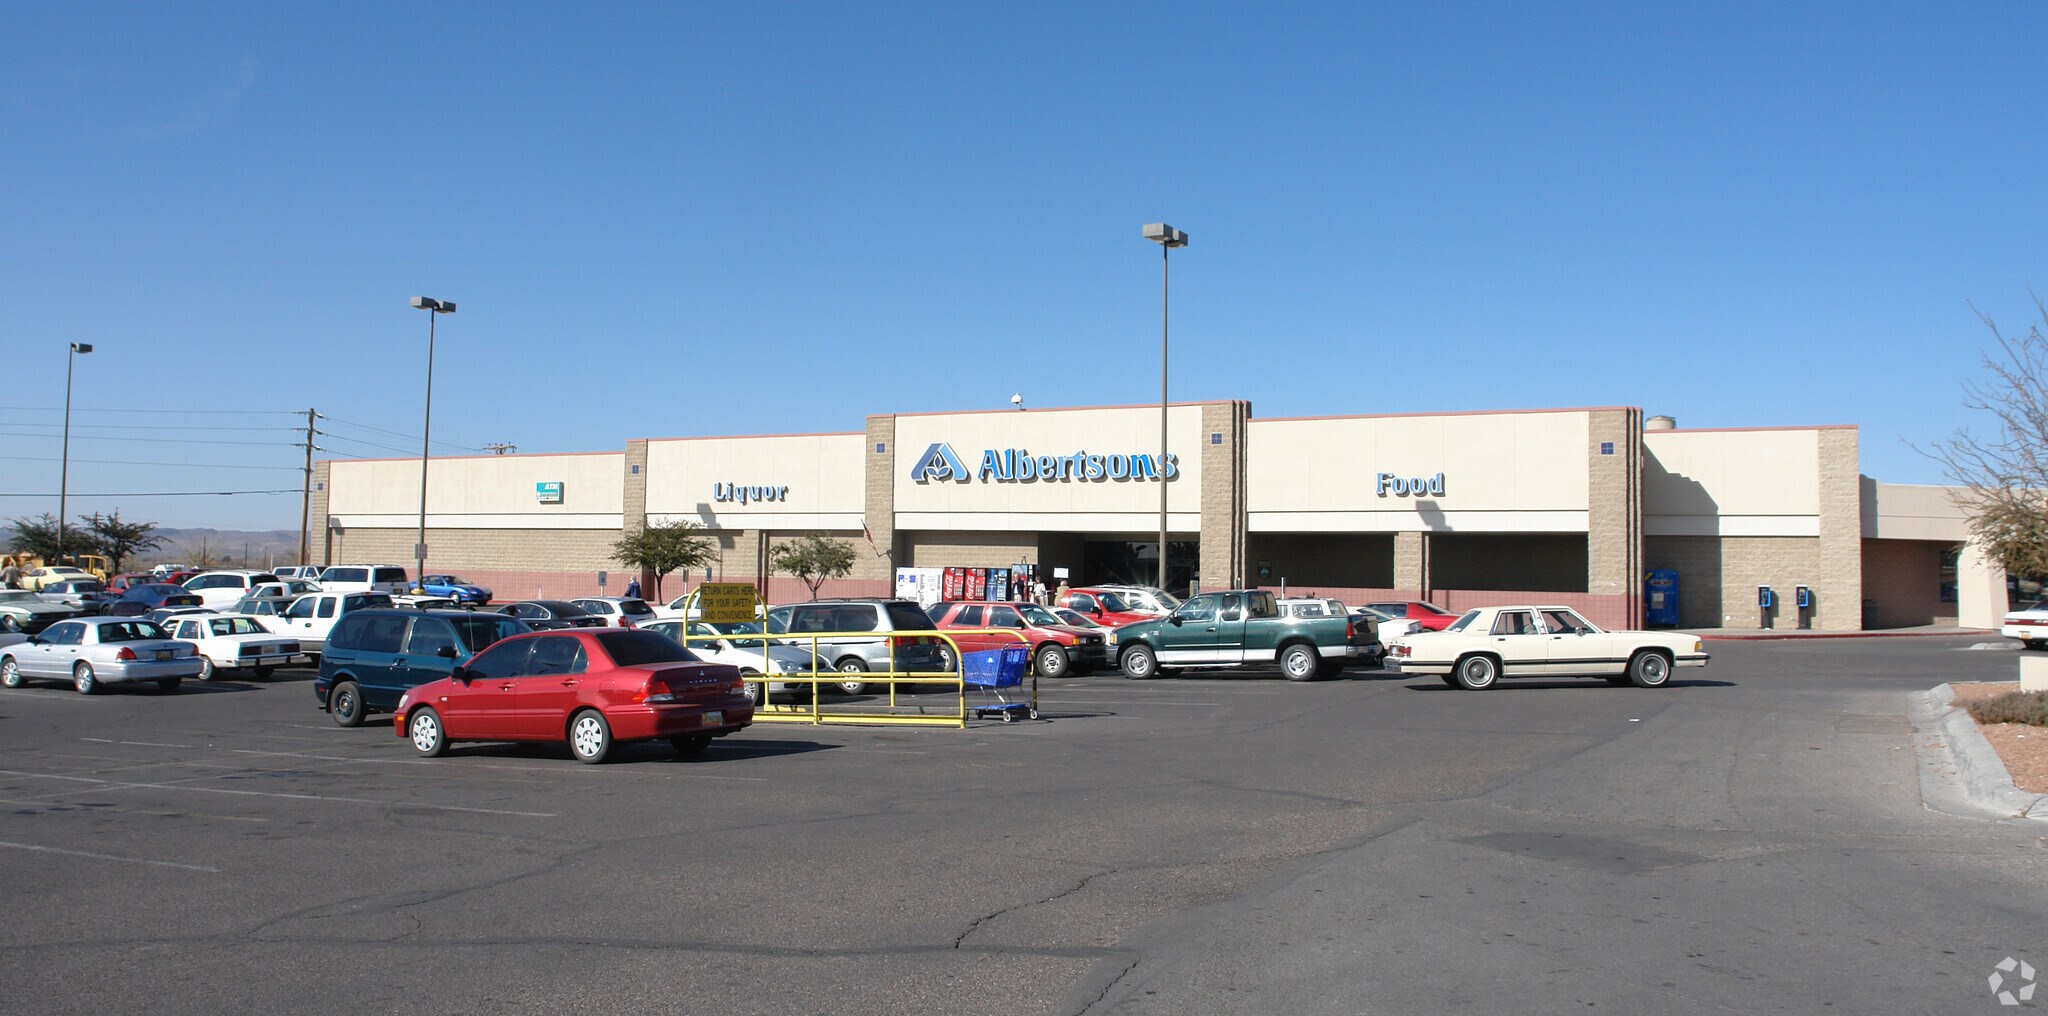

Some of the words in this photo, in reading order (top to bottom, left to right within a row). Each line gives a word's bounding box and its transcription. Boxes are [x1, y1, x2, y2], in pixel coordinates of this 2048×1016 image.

[978, 448, 1179, 482] Albertsons
[1376, 472, 1445, 498] Food
[713, 482, 789, 506] Liquor
[700, 586, 721, 596] RETURN
[723, 586, 740, 596] CARTS
[741, 586, 755, 596] HERE
[703, 598, 714, 608] FOR
[716, 598, 731, 608] YOUR
[732, 598, 752, 608] SAFETY
[704, 610, 716, 620] AND
[717, 610, 752, 620] CONVENIENCE
